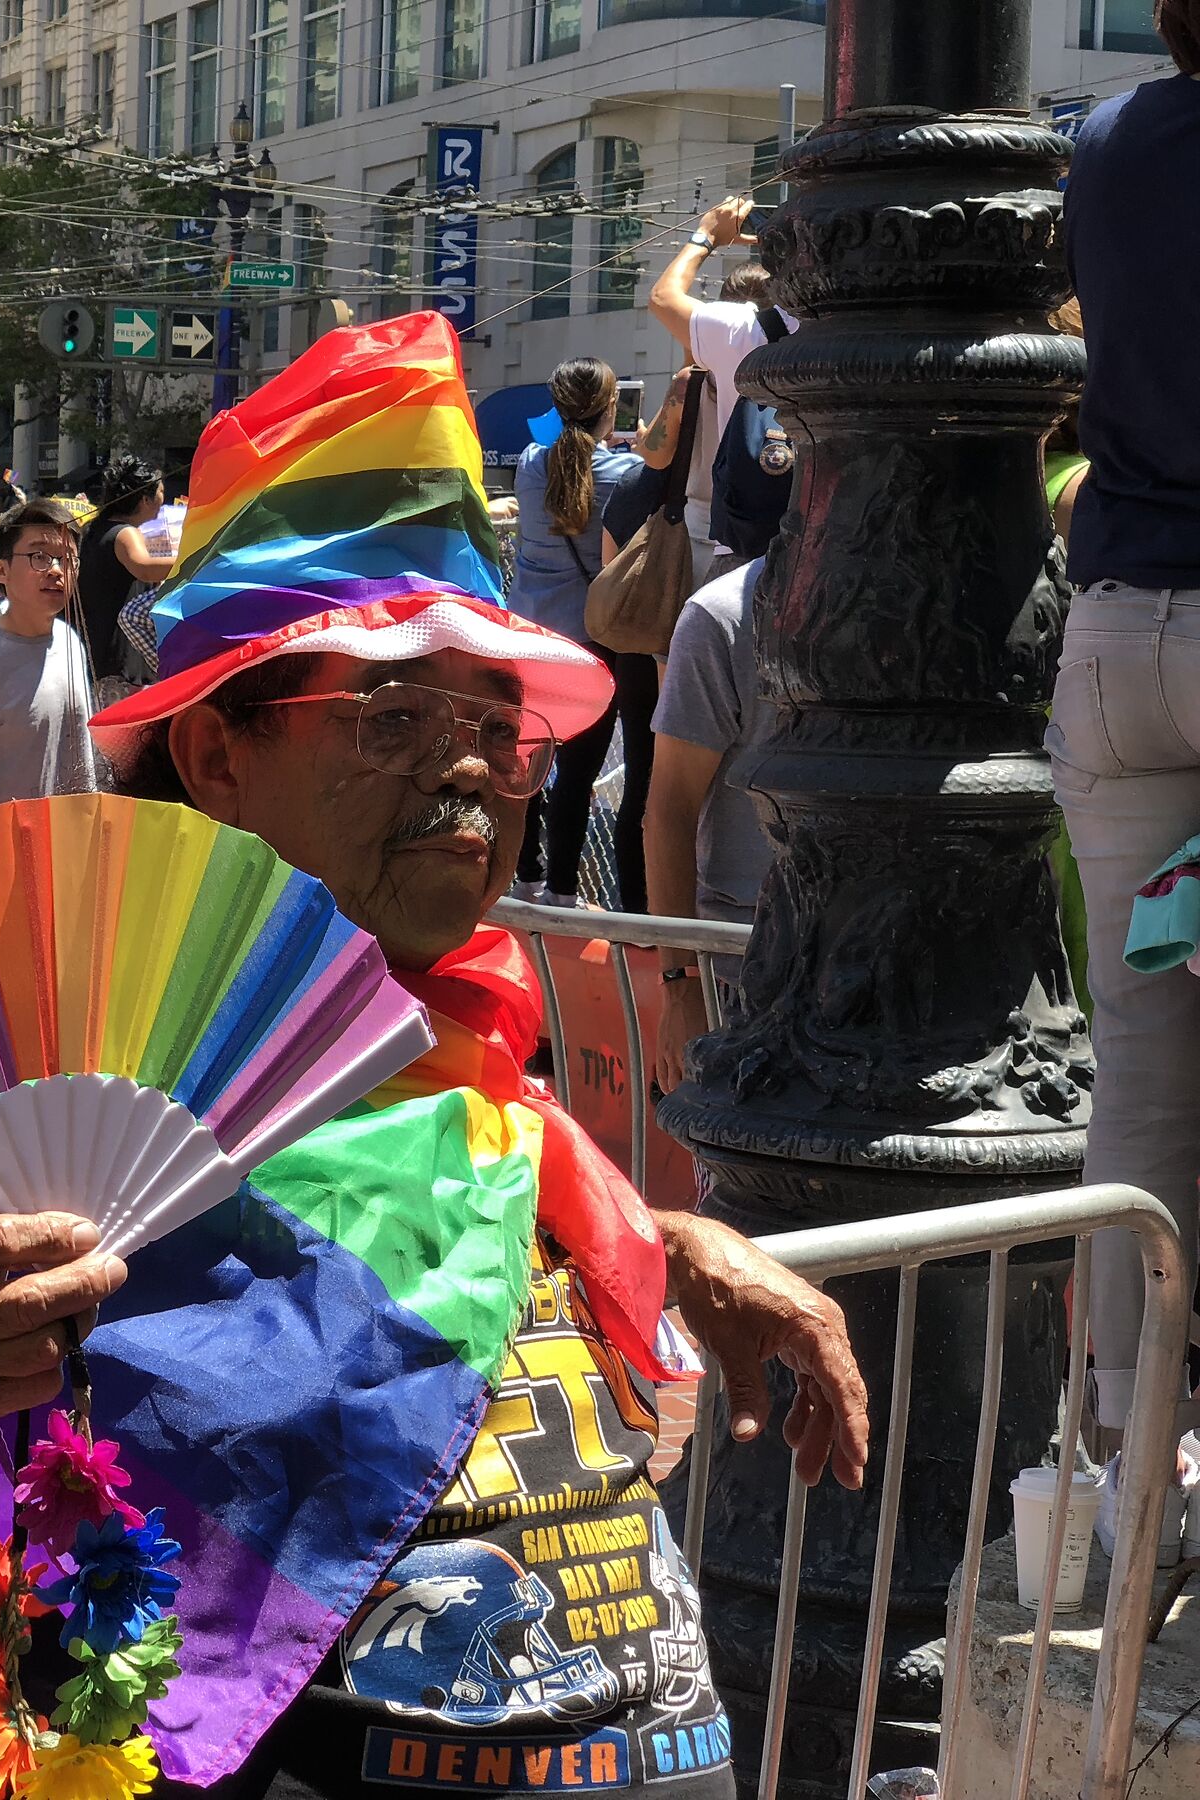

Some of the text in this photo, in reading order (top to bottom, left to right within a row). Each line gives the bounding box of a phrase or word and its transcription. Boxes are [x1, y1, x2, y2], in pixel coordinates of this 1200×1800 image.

[233, 269, 276, 280] FREEWAY
[116, 329, 150, 338] FREEWAY
[174, 332, 209, 341] ONE WAY
[580, 1048, 624, 1095] TPC
[521, 1513, 649, 1564] SAN FRANCISCO
[557, 1556, 642, 1601] BAY AREA
[624, 1668, 647, 1695] VS
[388, 1738, 617, 1786] DENVER
